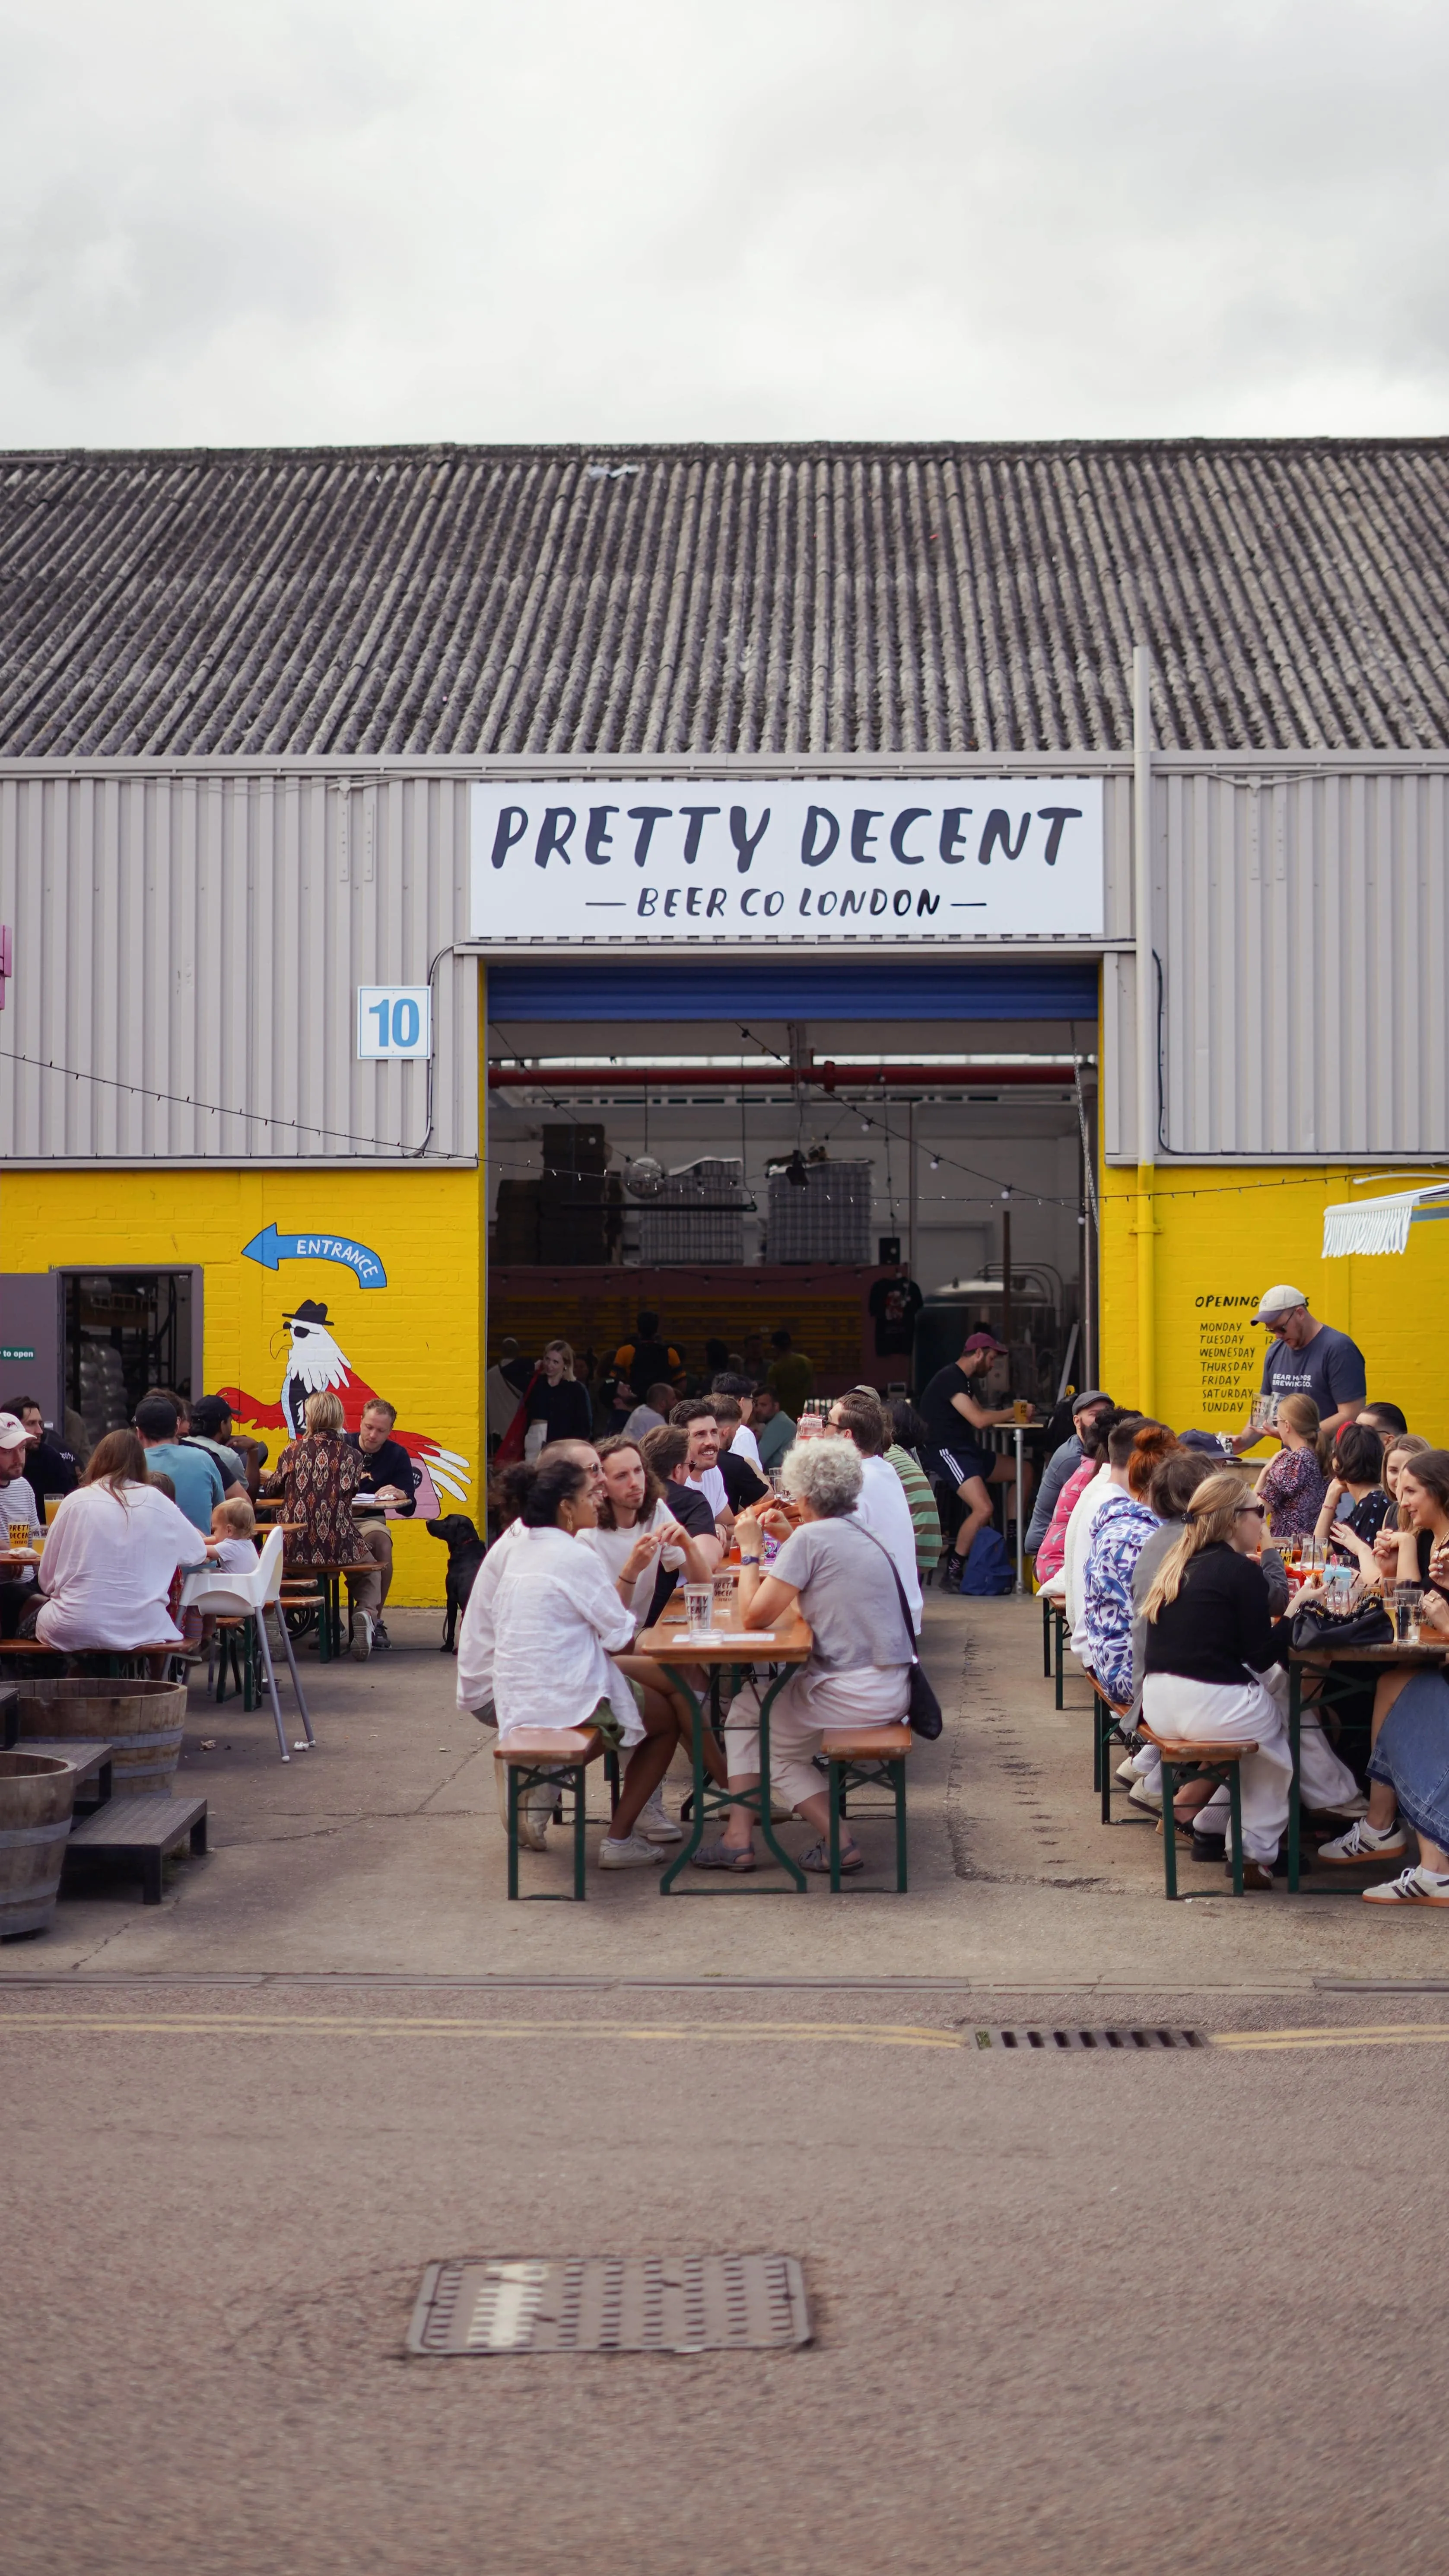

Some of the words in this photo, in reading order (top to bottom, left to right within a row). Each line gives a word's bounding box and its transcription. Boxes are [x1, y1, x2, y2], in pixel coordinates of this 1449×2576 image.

[491, 805, 771, 874] PRETTY
[801, 805, 1083, 867] DECENT
[637, 887, 728, 918] BEER
[740, 888, 785, 917] CO
[799, 888, 941, 917] LONDON
[369, 999, 419, 1047] 10
[297, 1239, 378, 1278] ENTRANCE
[1195, 1295, 1259, 1307] OPENING
[1200, 1322, 1242, 1332] MONDAY
[1200, 1335, 1244, 1344] TUESDAY
[1199, 1347, 1255, 1358] WEDNESDAY
[1200, 1361, 1254, 1372] THURSDAY
[1202, 1388, 1253, 1399] SATURDAY
[1202, 1402, 1244, 1412] SUNDAY
